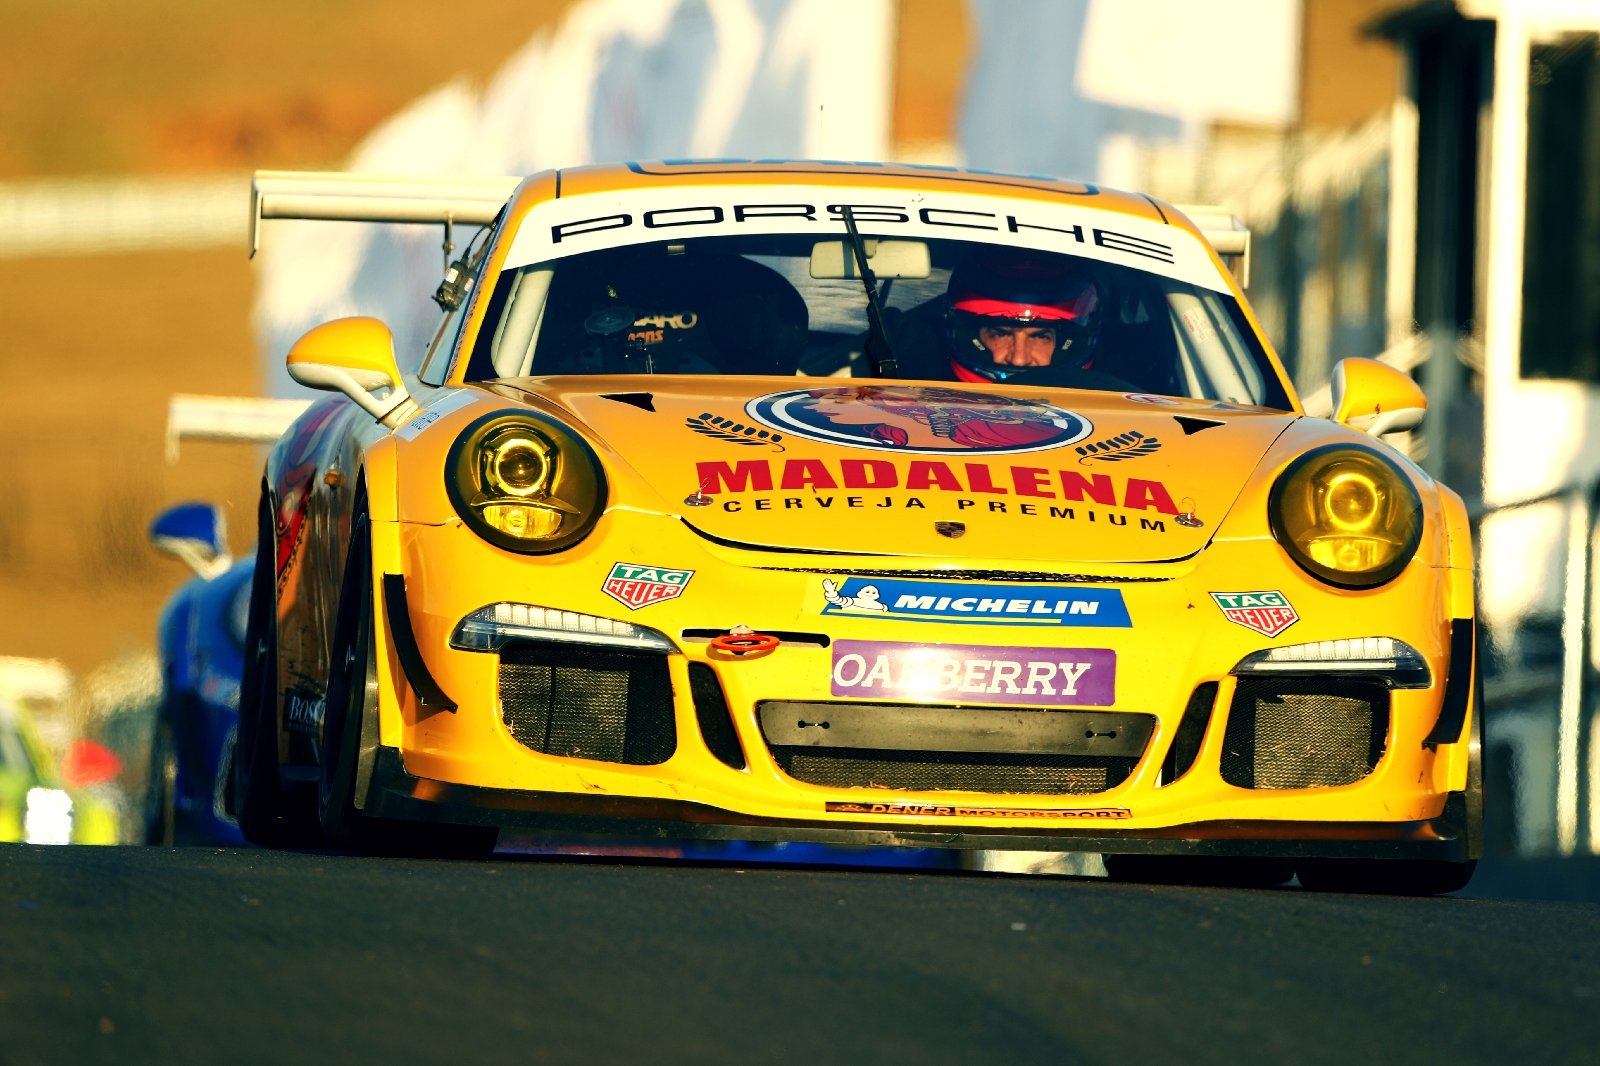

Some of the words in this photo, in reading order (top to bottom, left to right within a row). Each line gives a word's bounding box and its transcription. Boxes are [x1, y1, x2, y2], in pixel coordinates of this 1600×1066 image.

[552, 204, 1175, 264] PORSCHE
[695, 458, 1180, 515] MADALENA
[723, 496, 926, 513] CERVEJA
[957, 500, 1167, 533] PREMIUM
[620, 566, 683, 584] TAG
[608, 580, 678, 605] HEUER
[894, 594, 1099, 614] MICHELIN
[1218, 594, 1282, 607] TAG
[1229, 608, 1293, 631] HEUER
[833, 653, 1091, 696] OABERRY
[870, 803, 951, 816] DENER
[959, 809, 1126, 818] MOTORSPORT
